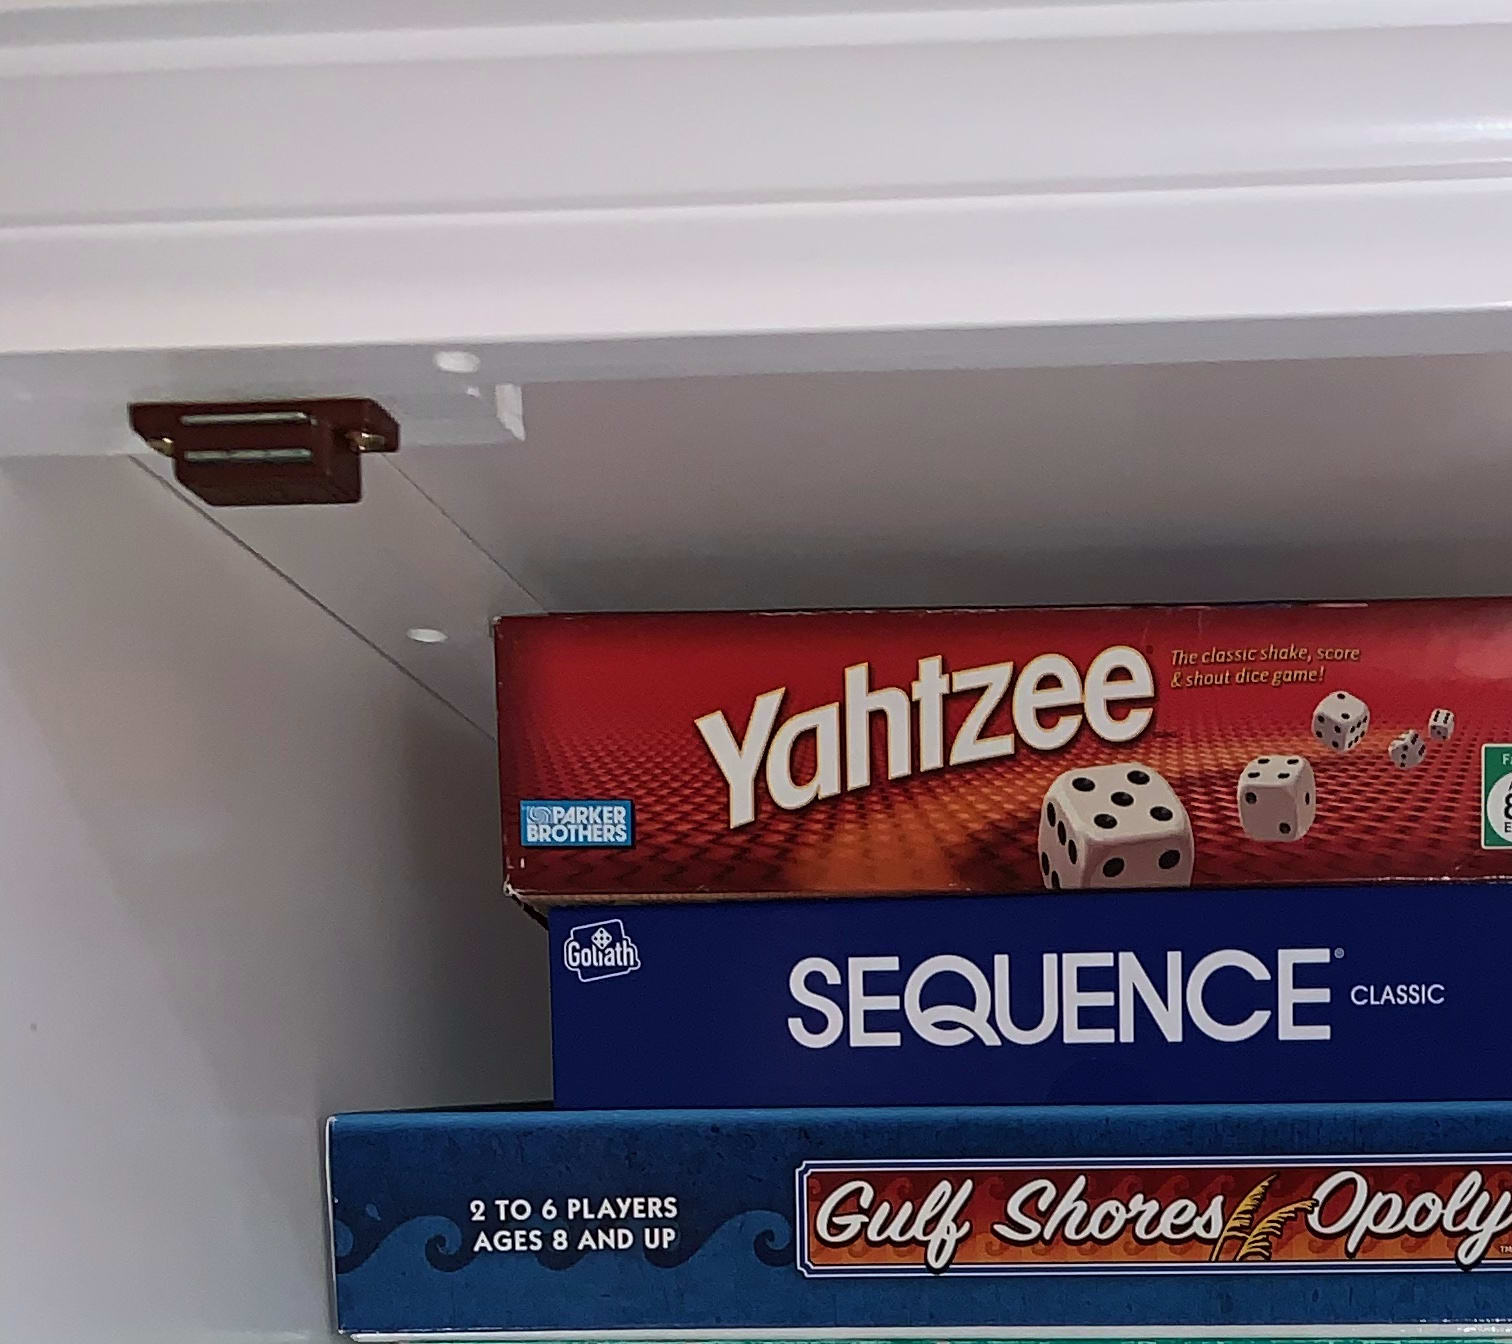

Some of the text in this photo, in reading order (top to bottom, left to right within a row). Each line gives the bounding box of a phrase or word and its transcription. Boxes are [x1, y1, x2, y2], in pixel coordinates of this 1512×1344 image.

[1171, 643, 1360, 666] The classic shake, score
[1170, 666, 1325, 688] & shout dice game!
[695, 644, 1154, 829] Yahtzee
[553, 804, 627, 825] PARKER
[526, 823, 627, 843] BROTHERS
[567, 937, 635, 969] Goliath
[787, 947, 1445, 1049] SEQUENCE CLASSIC
[469, 1196, 679, 1222] 2 TO 6 PLAYERS
[815, 1177, 975, 1270] Gulf
[992, 1174, 1224, 1247] Shores
[473, 1227, 677, 1252] AGES 8 AND UP
